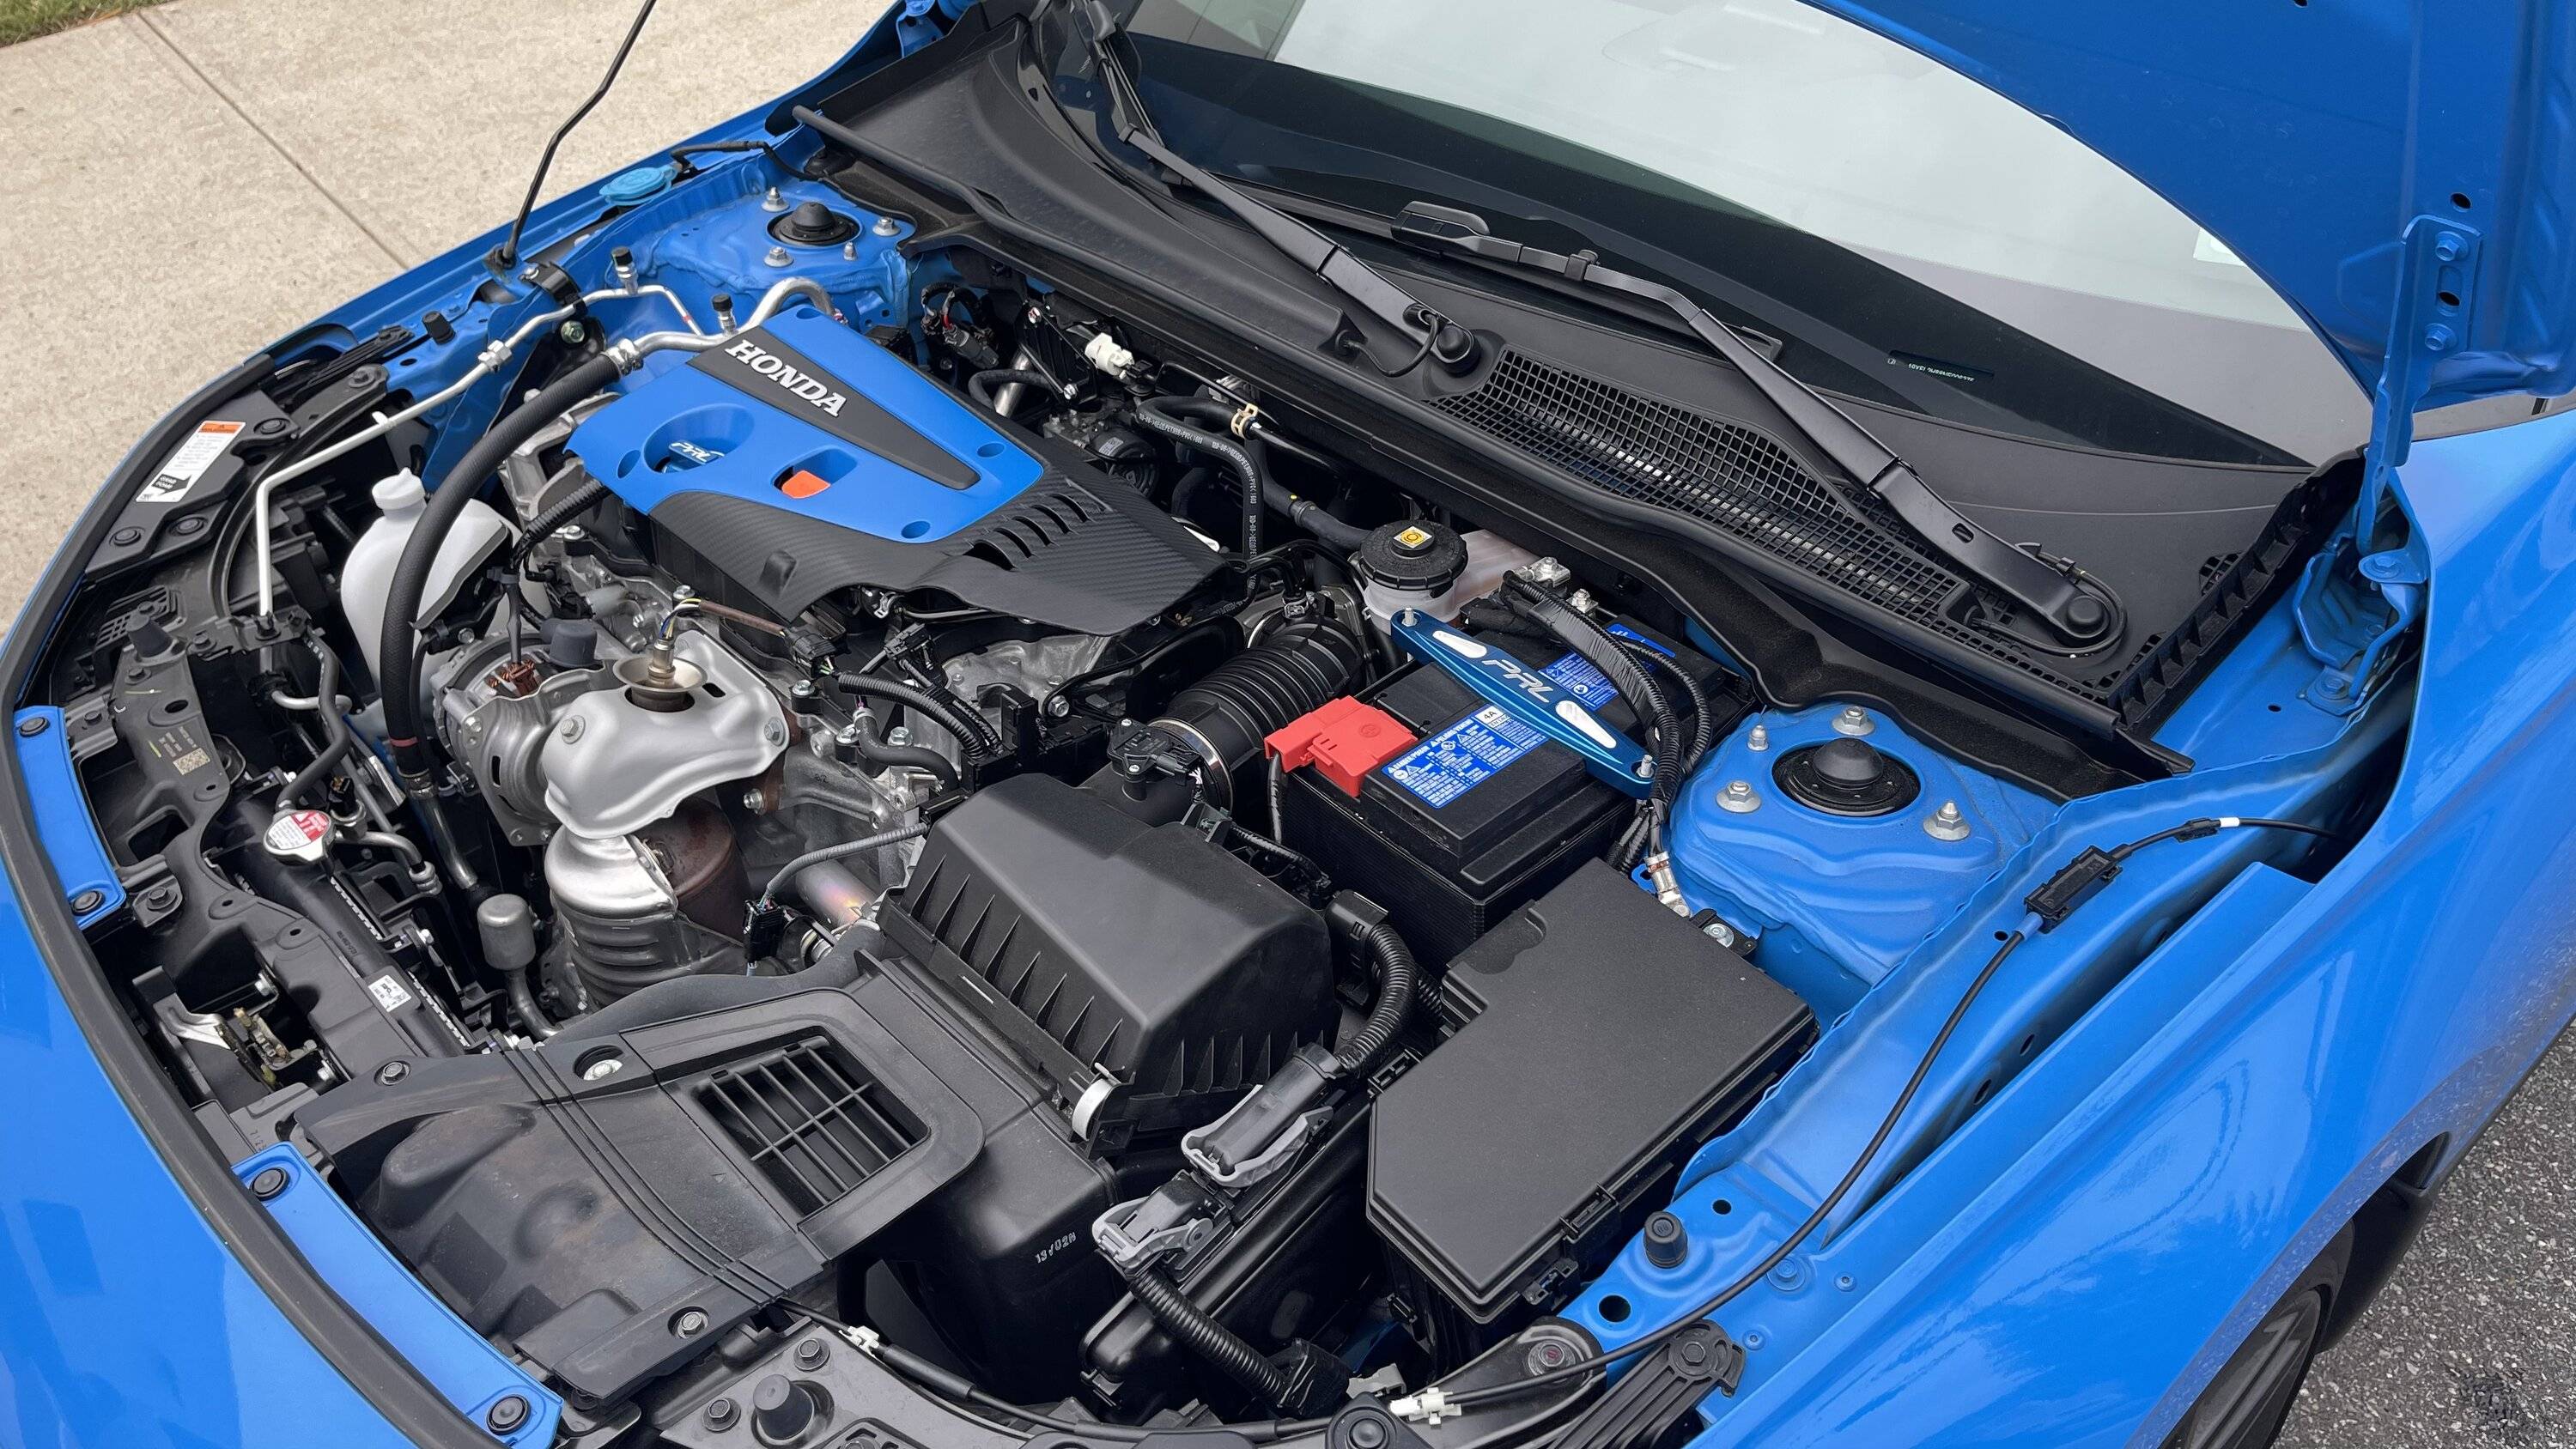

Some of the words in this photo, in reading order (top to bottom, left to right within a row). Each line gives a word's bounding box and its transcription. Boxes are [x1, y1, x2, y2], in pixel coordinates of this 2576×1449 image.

[725, 339, 847, 417] HONDA
[671, 442, 711, 462] PRL
[1481, 658, 1554, 703] PRL
